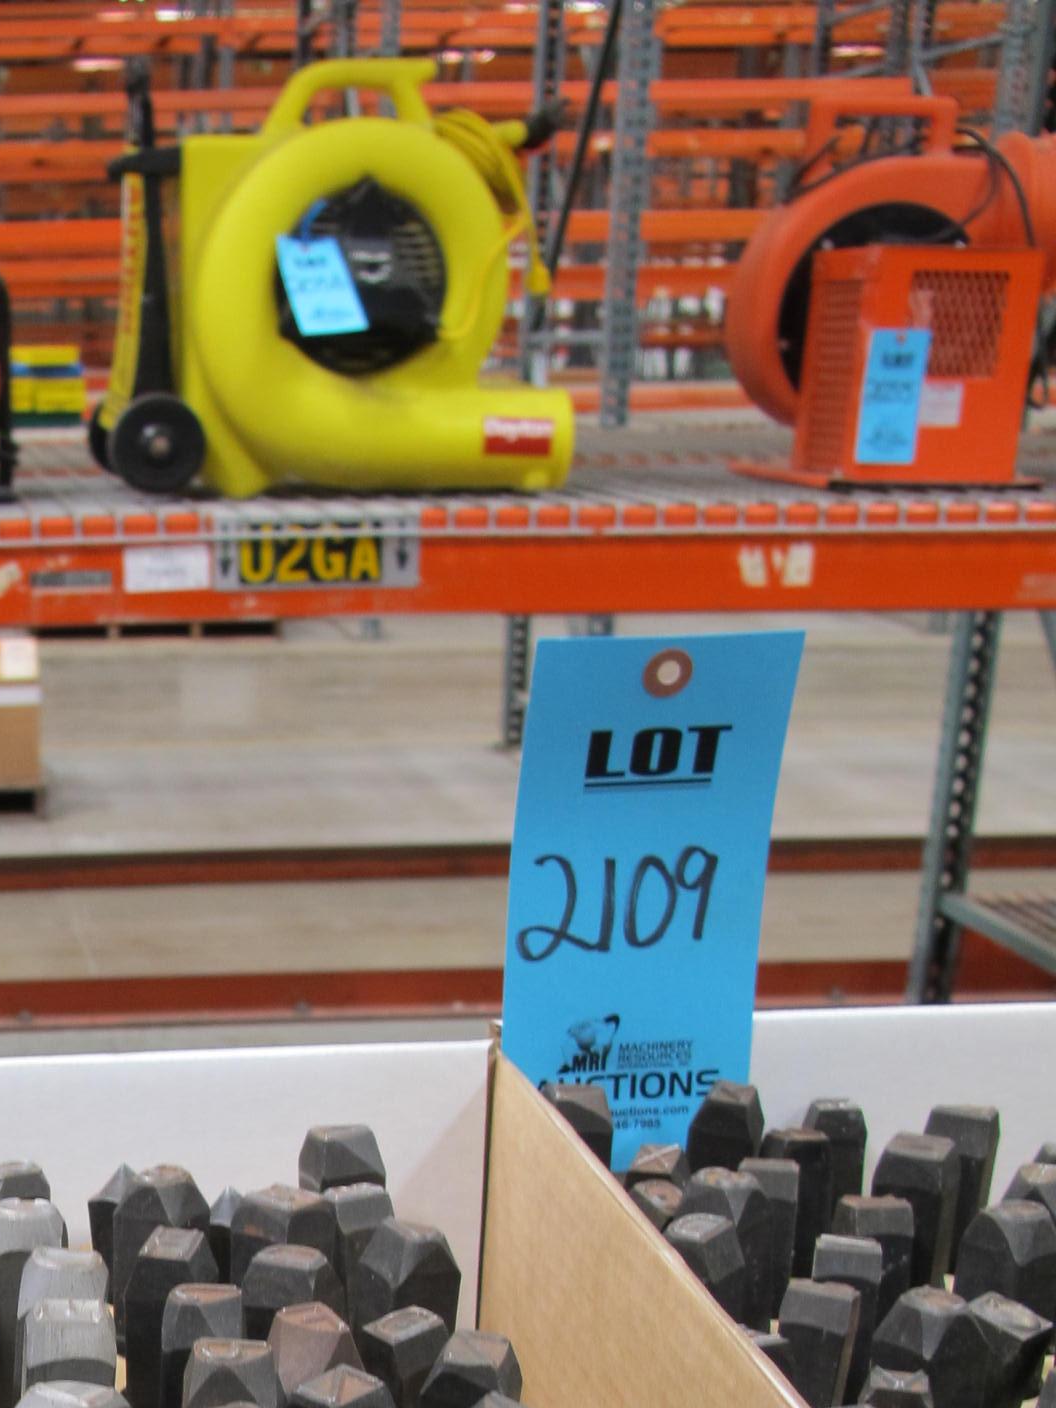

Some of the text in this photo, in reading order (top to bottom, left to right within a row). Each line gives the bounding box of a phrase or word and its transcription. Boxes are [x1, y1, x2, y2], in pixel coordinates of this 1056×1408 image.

[584, 725, 733, 779] LOT
[516, 846, 719, 963] 2109
[618, 1040, 694, 1052] MACHINERY
